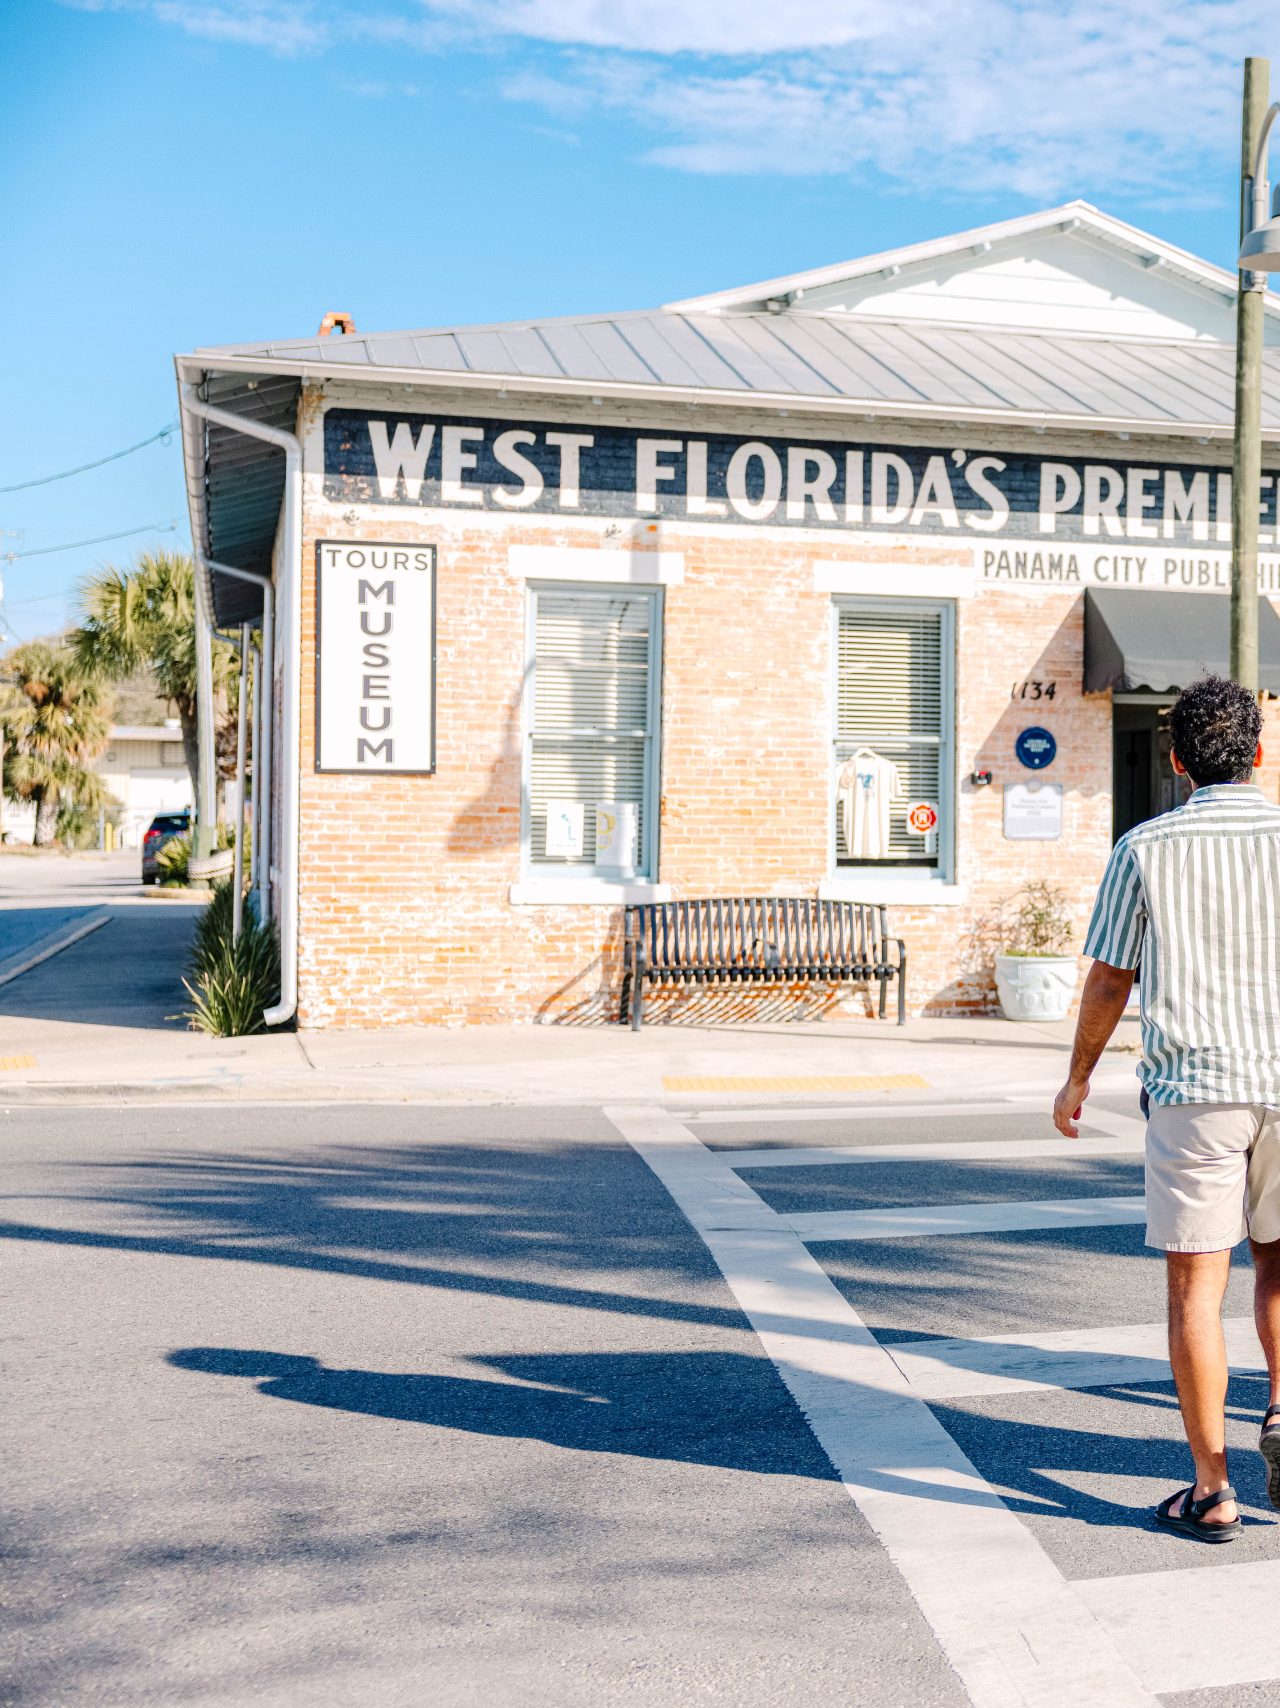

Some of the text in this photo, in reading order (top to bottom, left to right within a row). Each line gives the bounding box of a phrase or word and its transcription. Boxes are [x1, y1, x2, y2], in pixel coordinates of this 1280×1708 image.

[366, 419, 595, 508] WEST
[636, 439, 1010, 532] FLORIDA'S
[326, 549, 428, 572] TOURS
[984, 549, 1081, 581] PANAMA
[1093, 556, 1147, 583] CITY
[357, 578, 396, 764] MUSEUM
[1011, 681, 1057, 701] 1134
